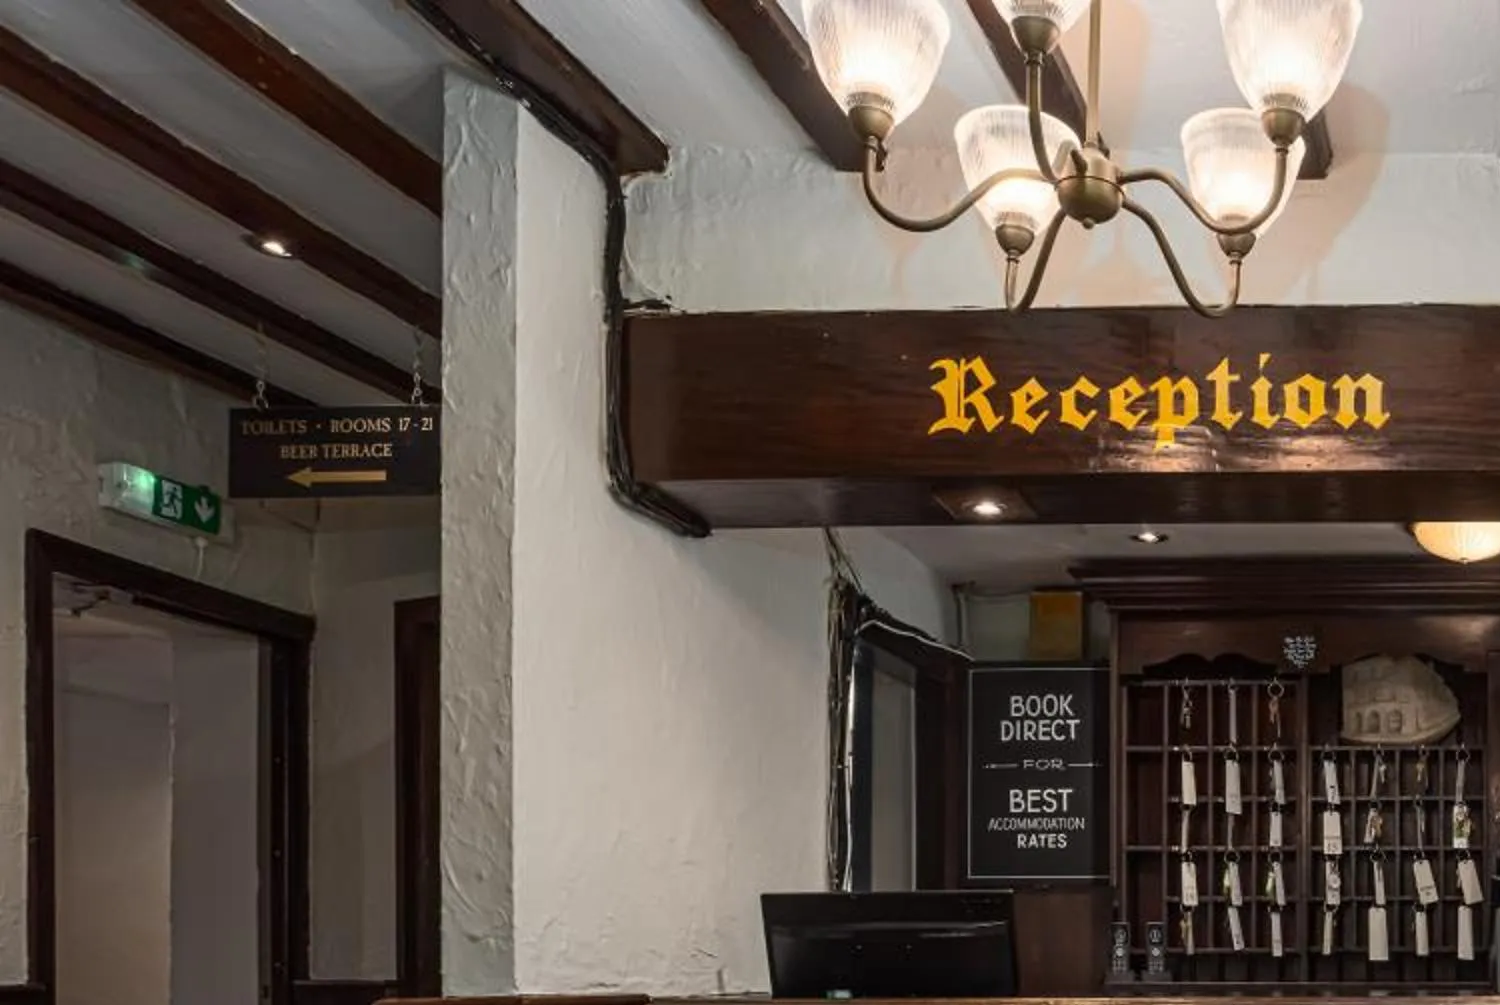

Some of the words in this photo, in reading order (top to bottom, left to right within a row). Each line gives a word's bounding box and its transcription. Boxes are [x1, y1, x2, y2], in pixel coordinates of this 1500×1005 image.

[927, 352, 1392, 449] Reception
[241, 419, 307, 435] TOILETS
[330, 418, 392, 433] ROOMS
[280, 445, 318, 459] BEER
[321, 443, 393, 459] TERRACE
[1010, 694, 1075, 717] BOOK
[1000, 719, 1081, 741] DIRECT
[1023, 759, 1066, 771] FOR
[1009, 788, 1073, 813] BEST
[988, 817, 1085, 831] ACCOMMODATION
[1017, 833, 1068, 849] RATES
